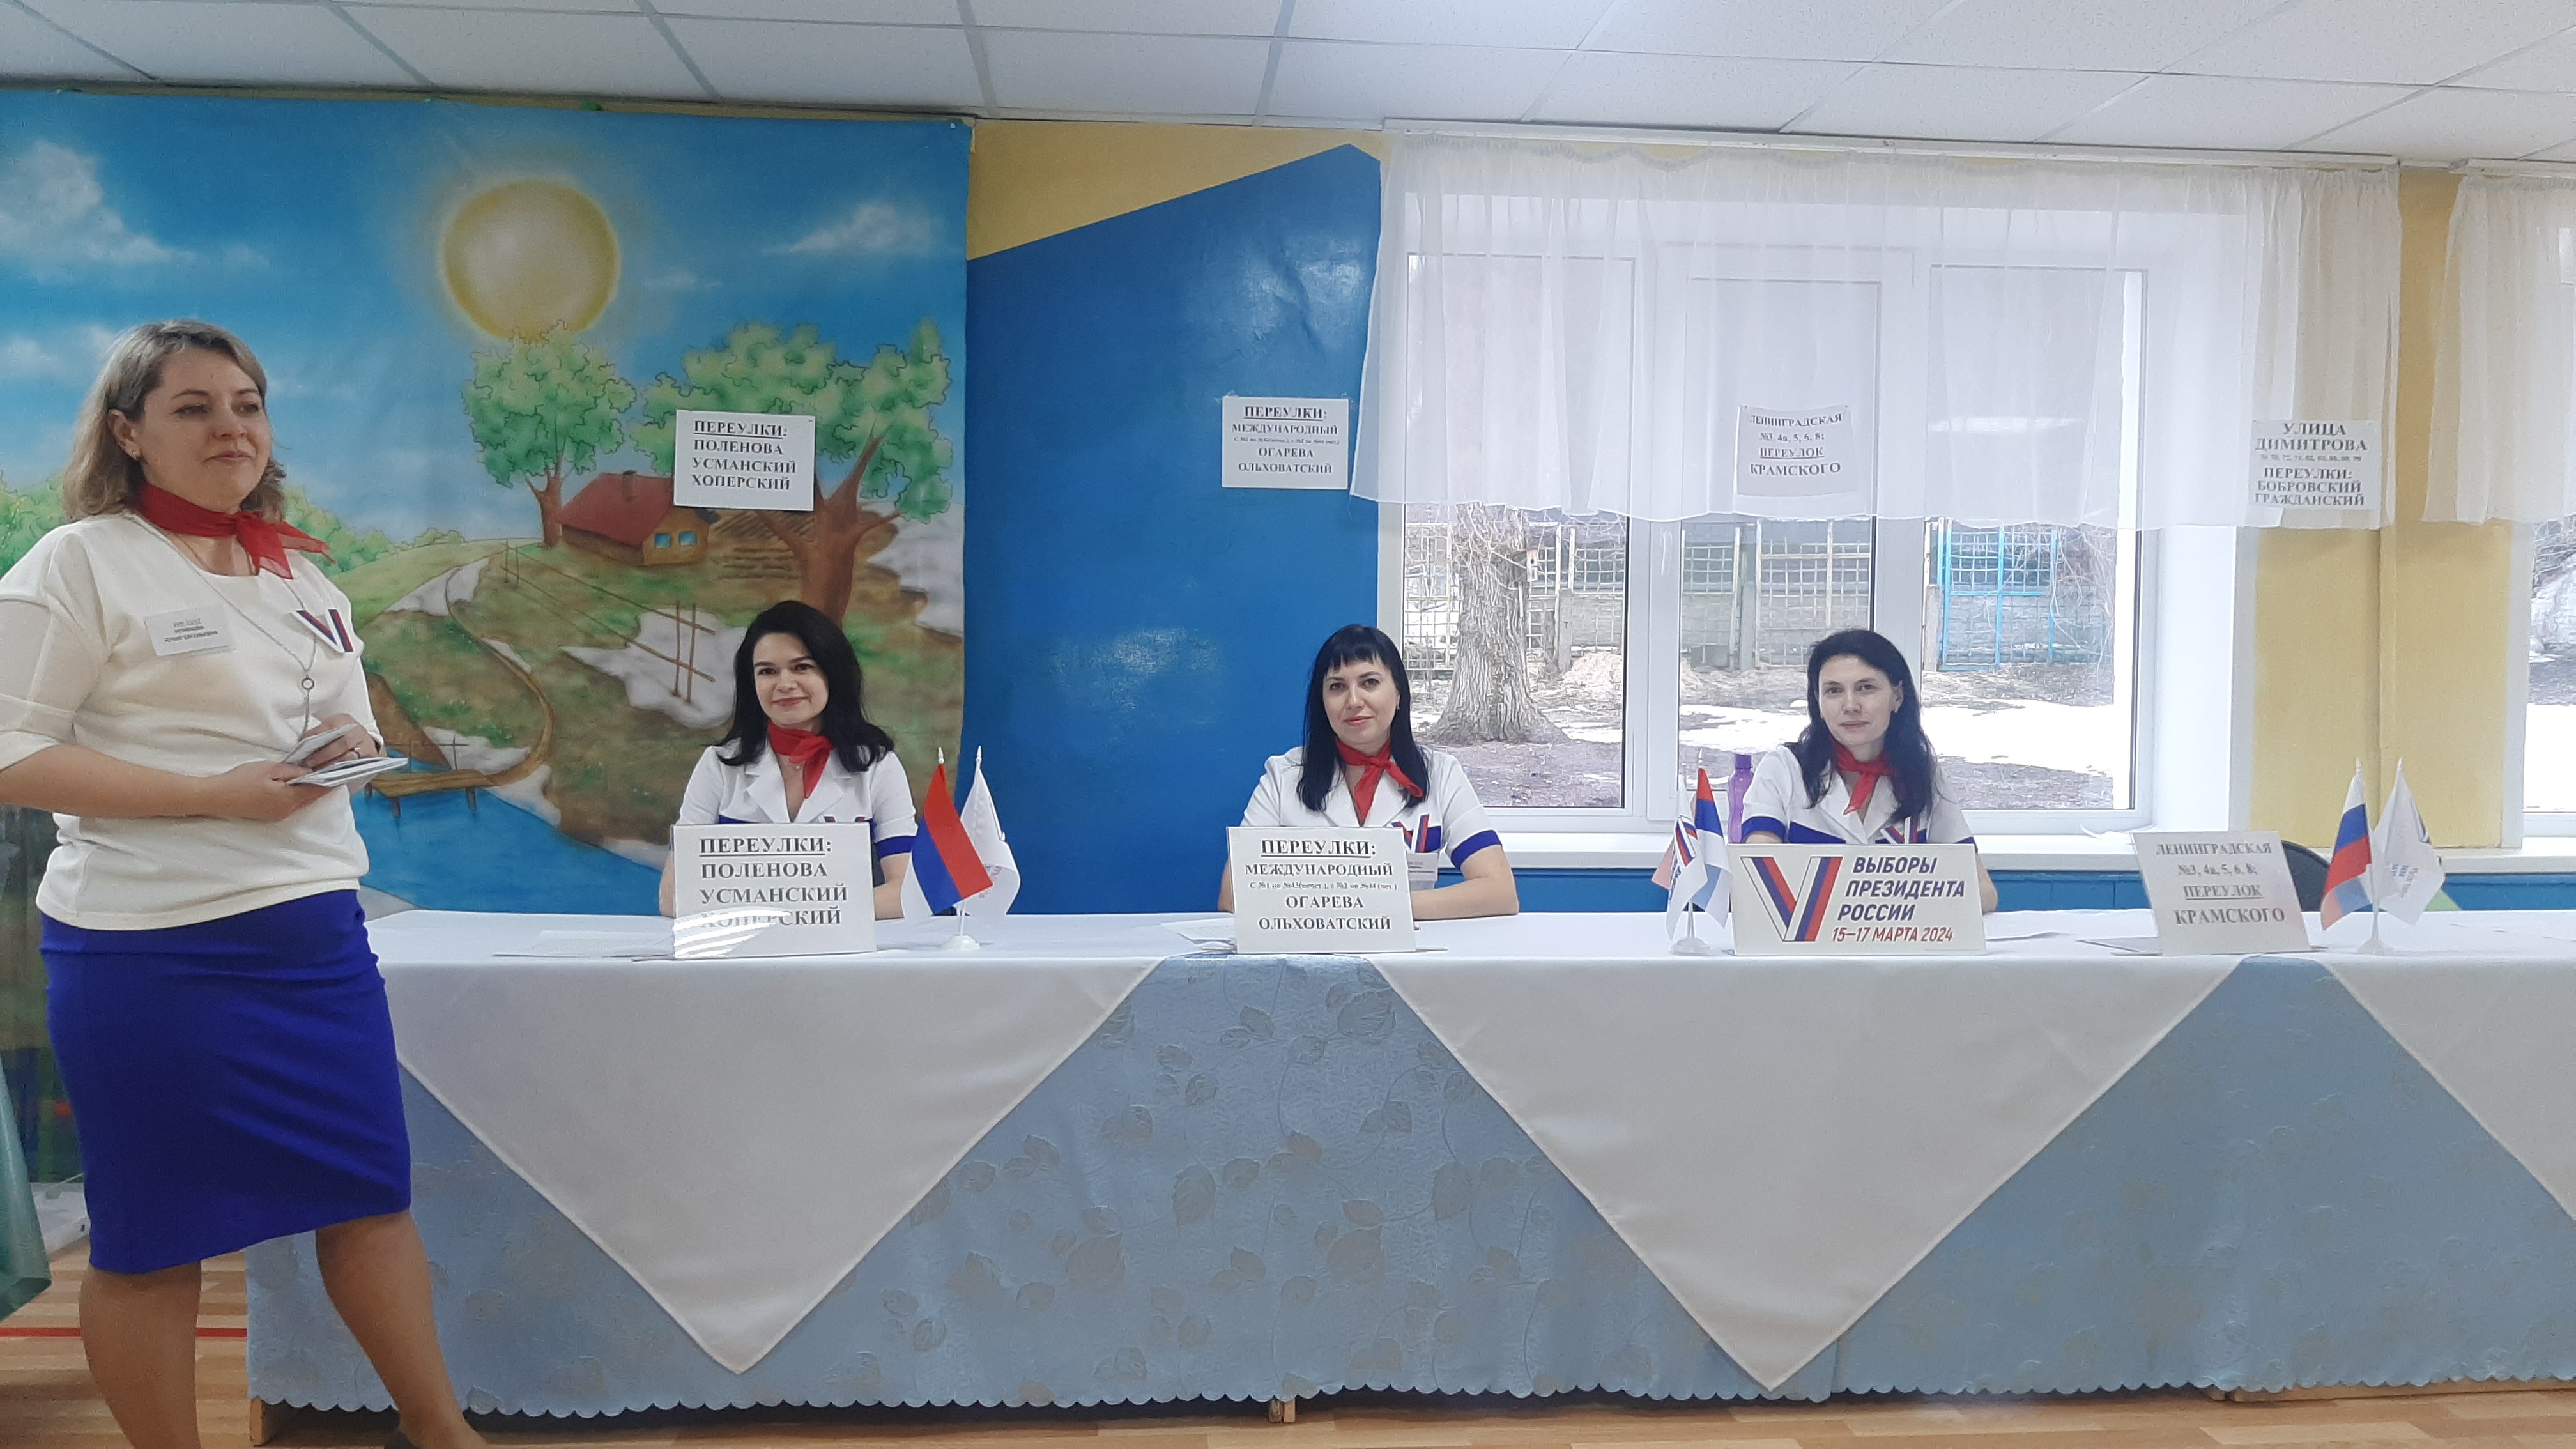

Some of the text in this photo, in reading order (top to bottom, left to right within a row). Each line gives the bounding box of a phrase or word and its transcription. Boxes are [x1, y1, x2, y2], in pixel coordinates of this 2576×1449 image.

[1245, 406, 1327, 419] ПЕРЕУЛКИ:
[1749, 413, 1842, 427] ЛЕНИНГРАДСКАЯ
[694, 420, 788, 437] ПЕРЕУЛКИ:
[1232, 423, 1338, 435] МЕЖДУНАРОДНЫЙ
[2283, 423, 2346, 436] УЛИЦА
[694, 439, 783, 455] ПОЛЕНОВА
[2255, 438, 2368, 451] ДИМИТРОВА
[1259, 447, 1314, 458] ОГАРЕВА
[1760, 447, 1824, 457] ПЕРЕУЛОК
[692, 457, 797, 473] УСМАНСКИЙ
[1238, 462, 1332, 474] ОЛЬХОВАТСКИЙ
[1751, 463, 1841, 476] КРАМСКОГО
[2264, 468, 2352, 479] ПЕРЕУЛКИ:
[691, 474, 790, 490] ХОПЕРСКИЙ
[2258, 480, 2361, 493] БОБРОВСКИЙ
[2255, 493, 2364, 506] ГРАЖДАНСКИЙ
[700, 838, 832, 854] ПЕРЕУЛКИ:
[1261, 840, 1376, 855] ПЕРЕУЛКИ:
[2156, 842, 2272, 855] ЛЕНИНГРАДСКАЯ
[702, 862, 828, 878] ПОЛЕНОВА
[1246, 862, 1393, 877] МЕЖДУНАРОДНЫЙ
[1853, 857, 1938, 874] ВЫБОРЫ
[700, 883, 848, 904] УСМАНСКИЙ
[1845, 880, 1965, 900] ПРЕЗИДЕНТА
[2182, 884, 2262, 898] ПЕРЕУЛОК
[1286, 896, 1365, 908] ОГАРЕВА
[1837, 904, 1916, 921] РОССИИ
[2175, 908, 2285, 924] КРАМСКОГО
[1259, 916, 1392, 930] ОЛЬХОВАТСКИЙ
[1872, 927, 1917, 942] МАРТА
[1920, 927, 1954, 942] 2024
